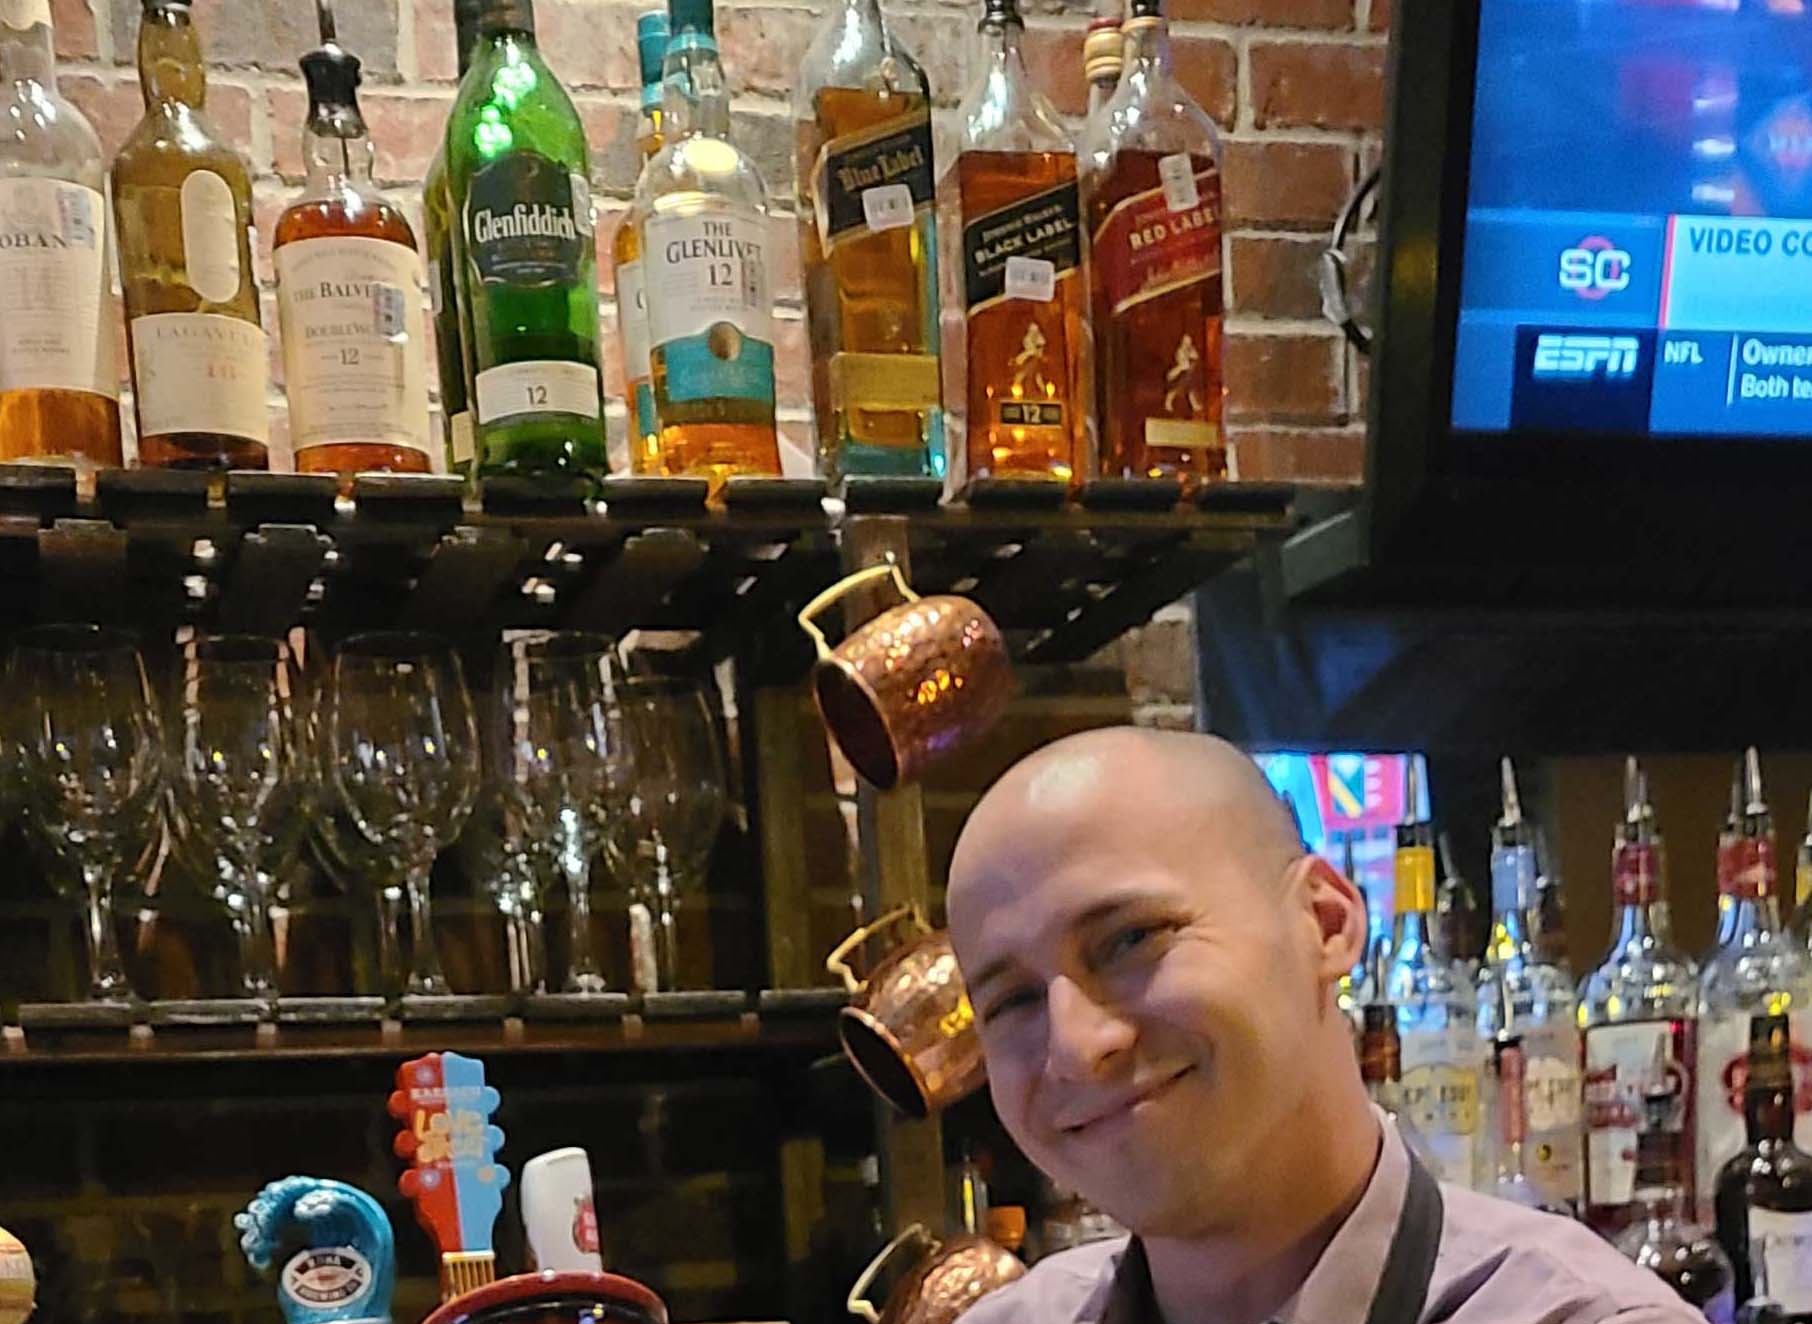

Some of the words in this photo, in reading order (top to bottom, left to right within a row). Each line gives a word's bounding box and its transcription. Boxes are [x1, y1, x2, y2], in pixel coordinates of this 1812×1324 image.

[475, 203, 576, 243] Glenfiddich
[703, 221, 732, 237] THE
[1129, 224, 1167, 251] RED
[1169, 207, 1215, 234] LABE
[974, 234, 1024, 264] BLACK
[1025, 218, 1075, 244] LABEL
[1689, 227, 1773, 255] VIDEO
[709, 263, 733, 286] 12
[1559, 248, 1632, 290] SC
[341, 349, 360, 366] 12
[1534, 334, 1639, 374] ESPN
[1664, 340, 1704, 365] NFL
[525, 385, 548, 405] 12
[1740, 373, 1790, 399] Both
[1022, 404, 1041, 423] 12
